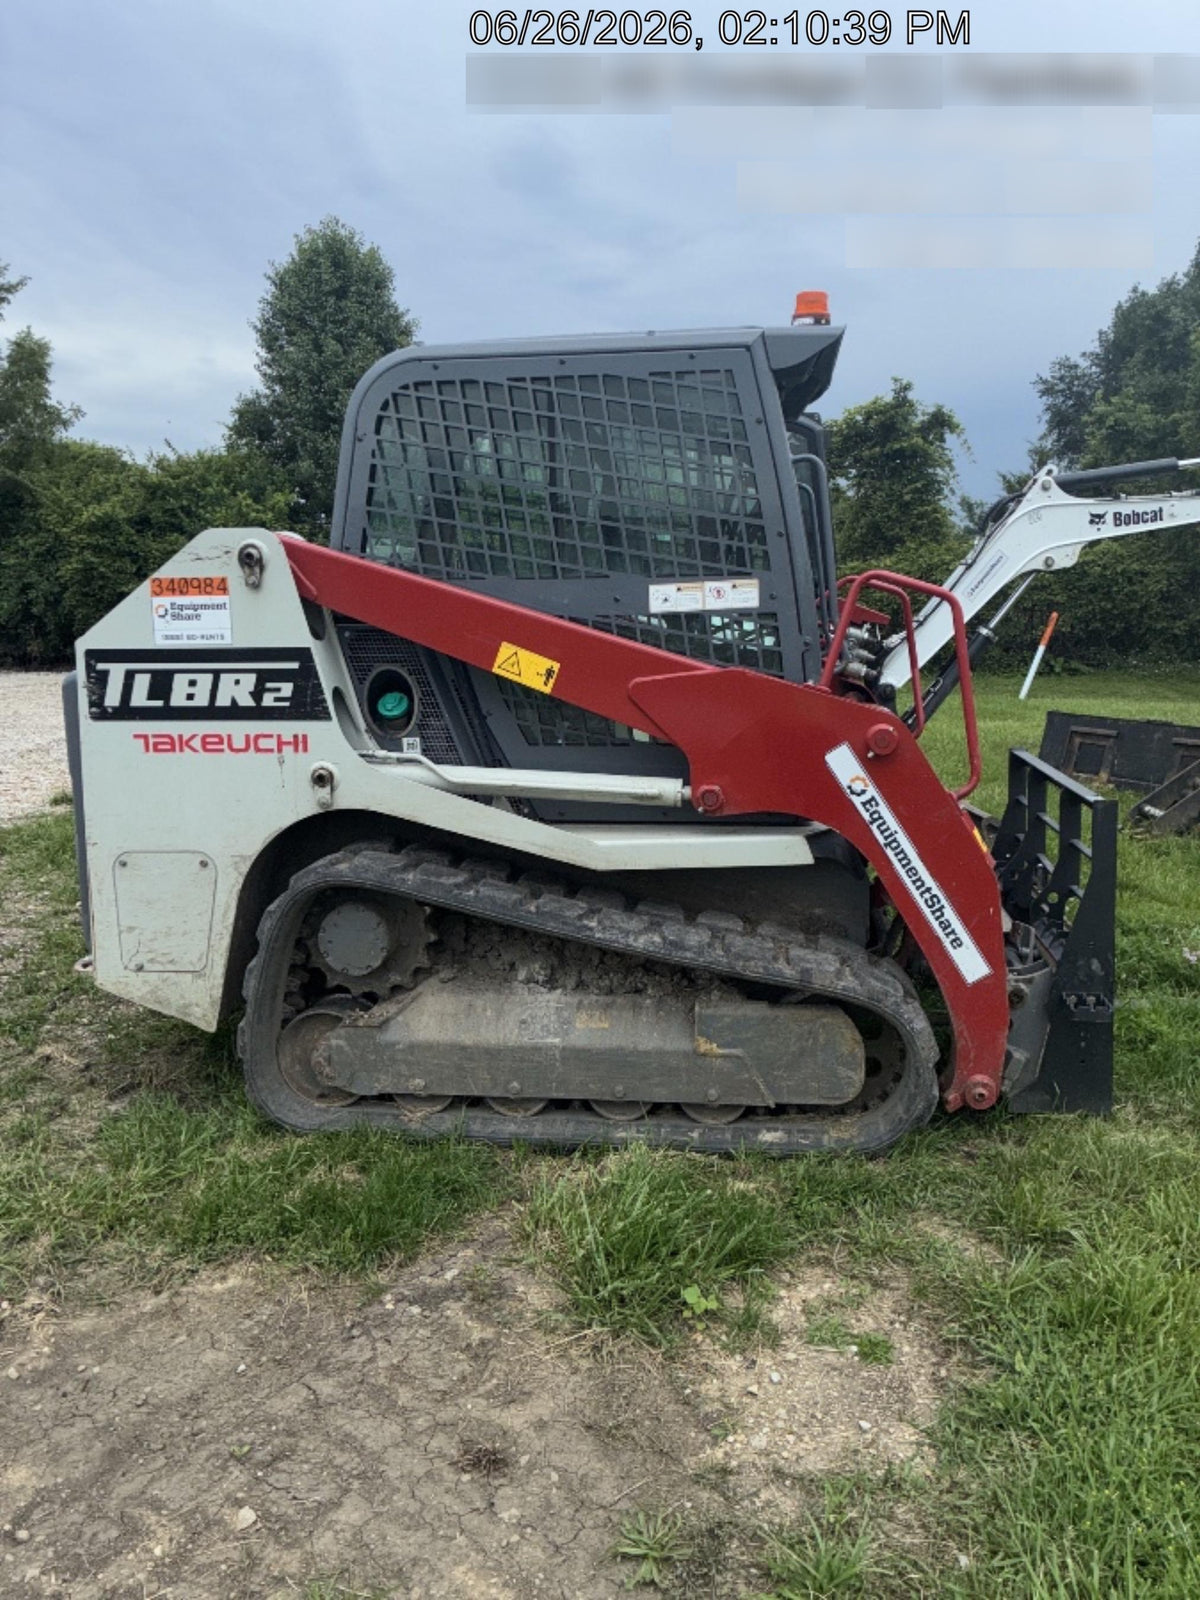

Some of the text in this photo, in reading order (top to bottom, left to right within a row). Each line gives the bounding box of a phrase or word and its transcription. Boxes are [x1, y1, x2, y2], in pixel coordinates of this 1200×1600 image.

[1112, 506, 1164, 527] Bobcat
[151, 577, 228, 596] 340984
[170, 602, 228, 612] Equipment
[170, 612, 202, 621] Share
[860, 794, 964, 950] EquipmentShare
